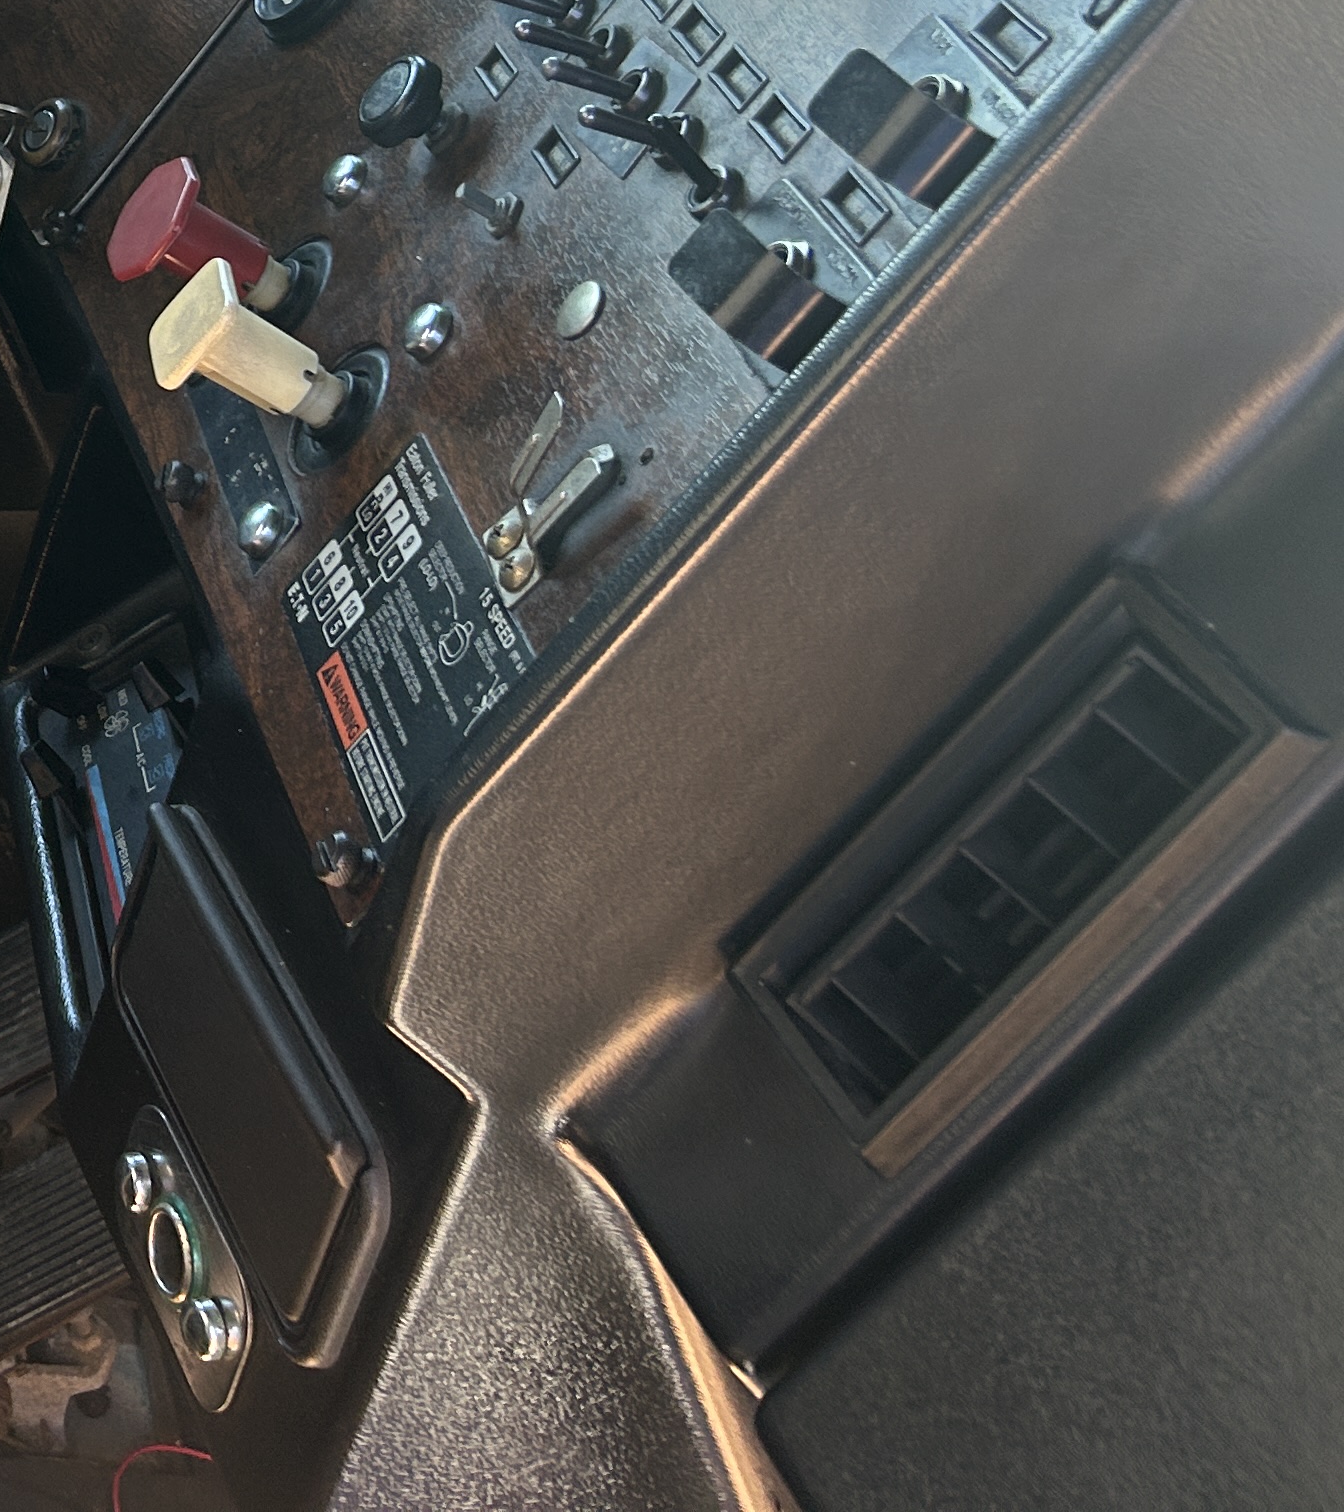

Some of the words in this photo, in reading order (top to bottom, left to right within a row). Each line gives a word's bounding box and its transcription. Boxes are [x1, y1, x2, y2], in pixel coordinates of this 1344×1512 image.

[479, 588, 494, 608] 15
[488, 603, 515, 649] SPEED
[332, 675, 360, 741] WARNING
[114, 827, 133, 887] TEMPERATURE
